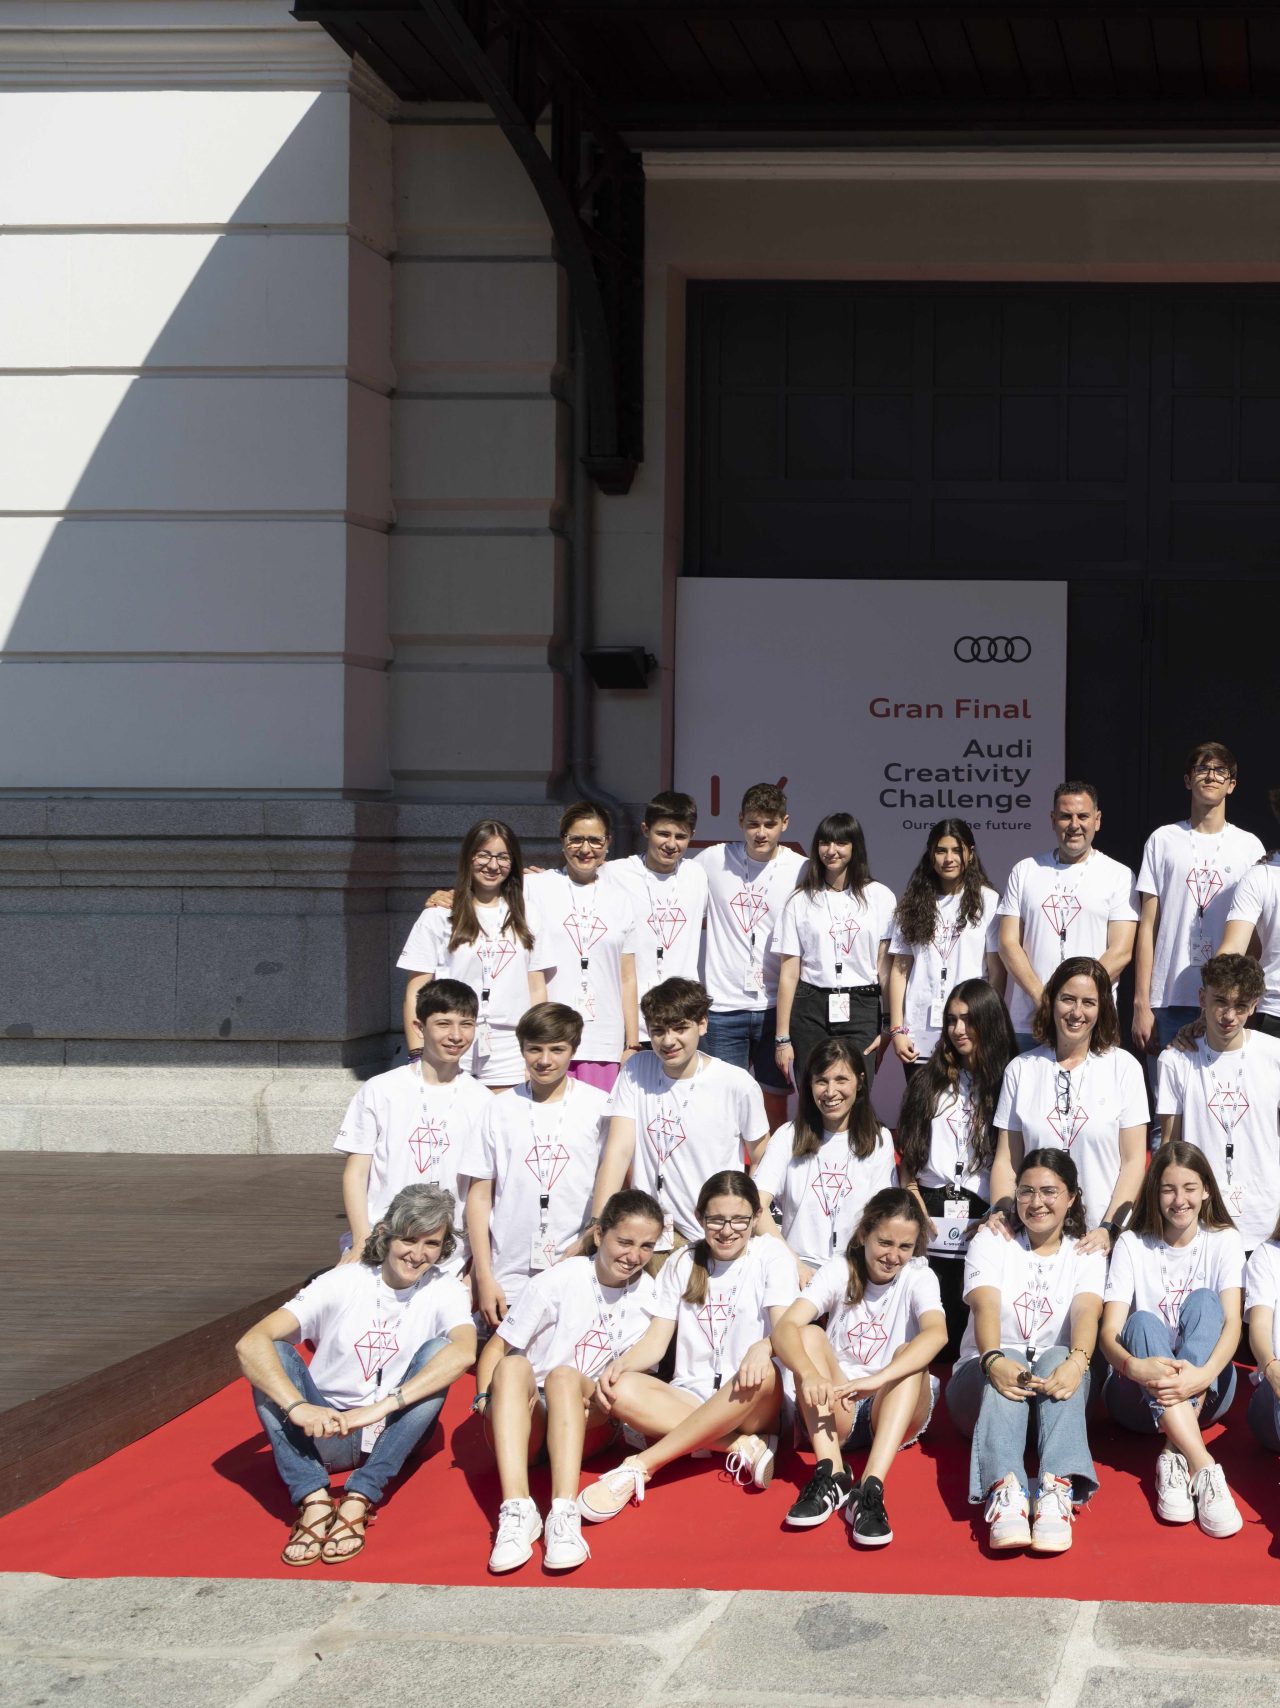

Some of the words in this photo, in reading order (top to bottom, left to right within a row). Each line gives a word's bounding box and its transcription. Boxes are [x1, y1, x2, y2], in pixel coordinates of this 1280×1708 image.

[869, 697, 944, 719] Gran
[955, 698, 1032, 719] Final
[962, 739, 1032, 759] Audi
[883, 763, 1032, 788] Creativity
[879, 788, 1032, 814] Challenge
[902, 820, 937, 830] Ours
[985, 820, 1032, 830] future
